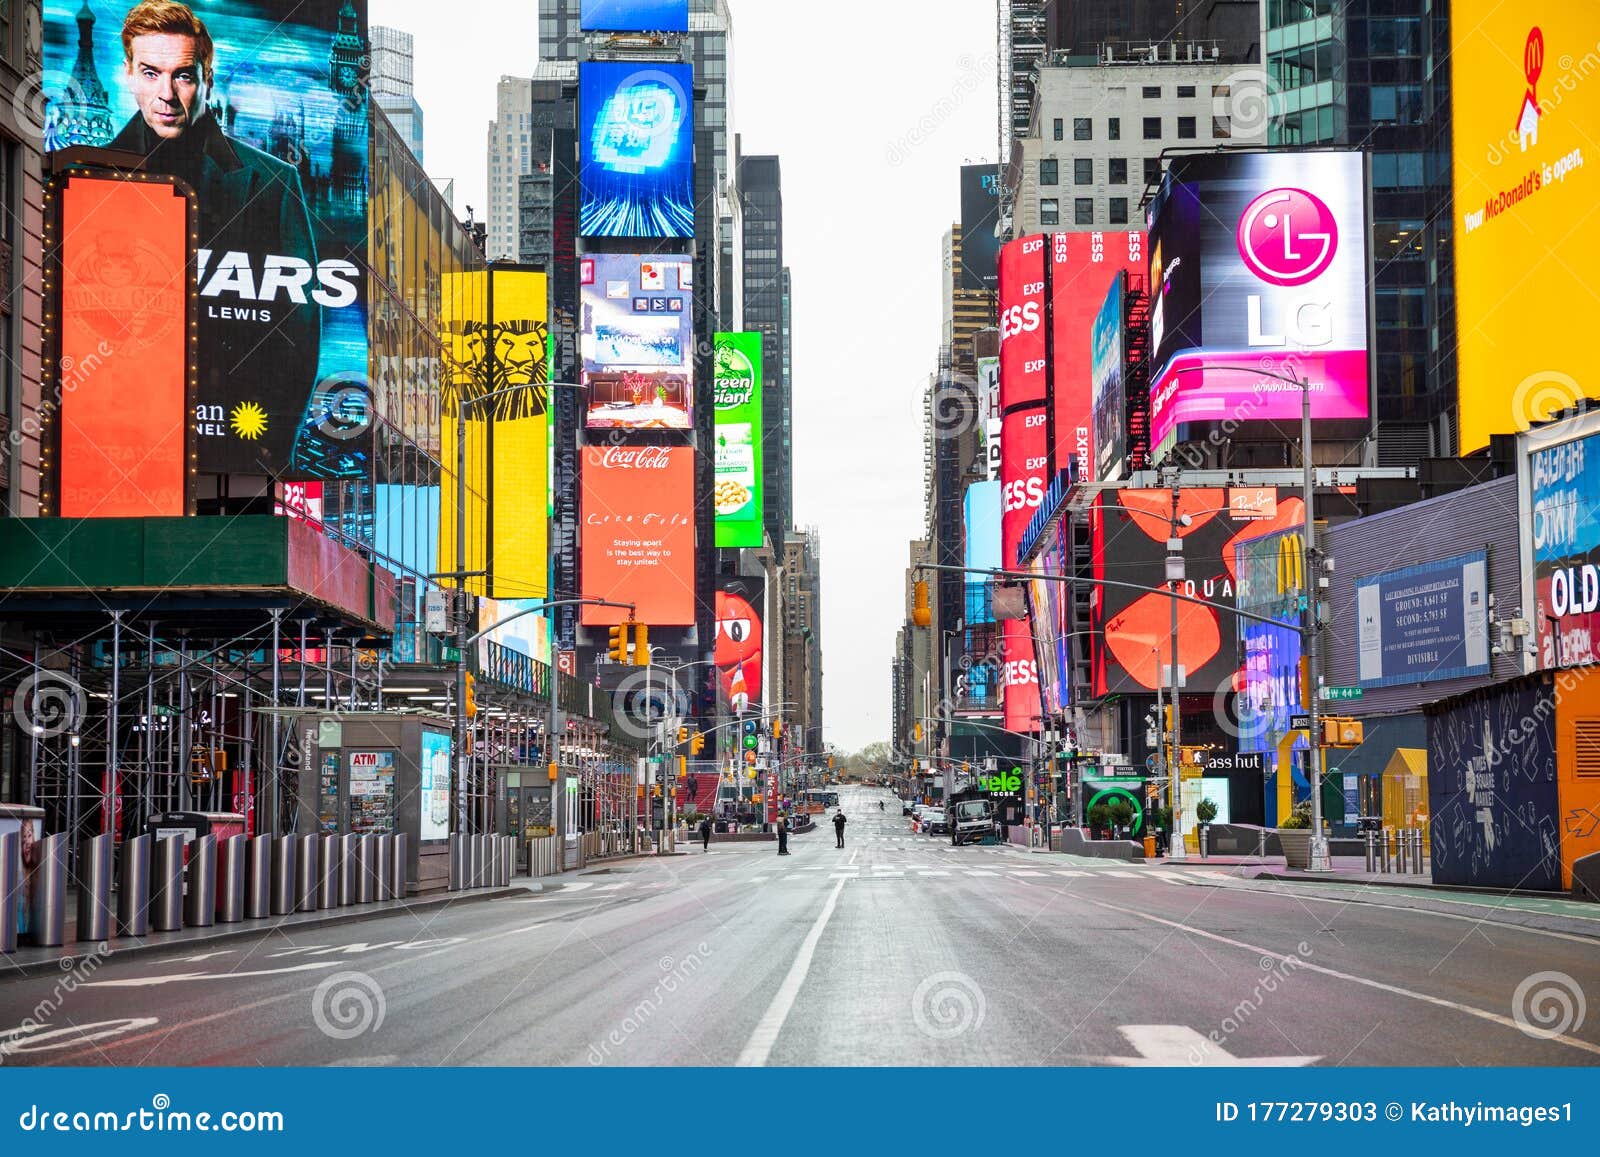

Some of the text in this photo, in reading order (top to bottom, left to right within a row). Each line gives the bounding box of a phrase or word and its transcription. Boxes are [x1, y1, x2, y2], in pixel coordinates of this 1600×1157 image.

[1464, 147, 1583, 234] Your McDonald's is open,
[1023, 240, 1044, 254] EXP
[1024, 282, 1045, 296] EXP
[208, 306, 272, 322] LEWIS
[1247, 295, 1334, 347] LG
[1025, 360, 1045, 373] EXP
[1026, 415, 1046, 428] EXP
[603, 446, 673, 468] Coca-Cola
[1026, 457, 1047, 471] EXP
[613, 539, 662, 548] Staying apart
[606, 549, 671, 559] is the best way to
[616, 559, 632, 568] stay
[1552, 564, 1599, 617] OLD
[1395, 597, 1422, 612] GROUND:
[1396, 612, 1422, 627] SECOND:
[1407, 650, 1438, 665] DIVISIBLE
[1330, 689, 1339, 698] W
[1341, 689, 1353, 698] 44
[353, 754, 376, 765] ATM
[1236, 753, 1260, 768] hut
